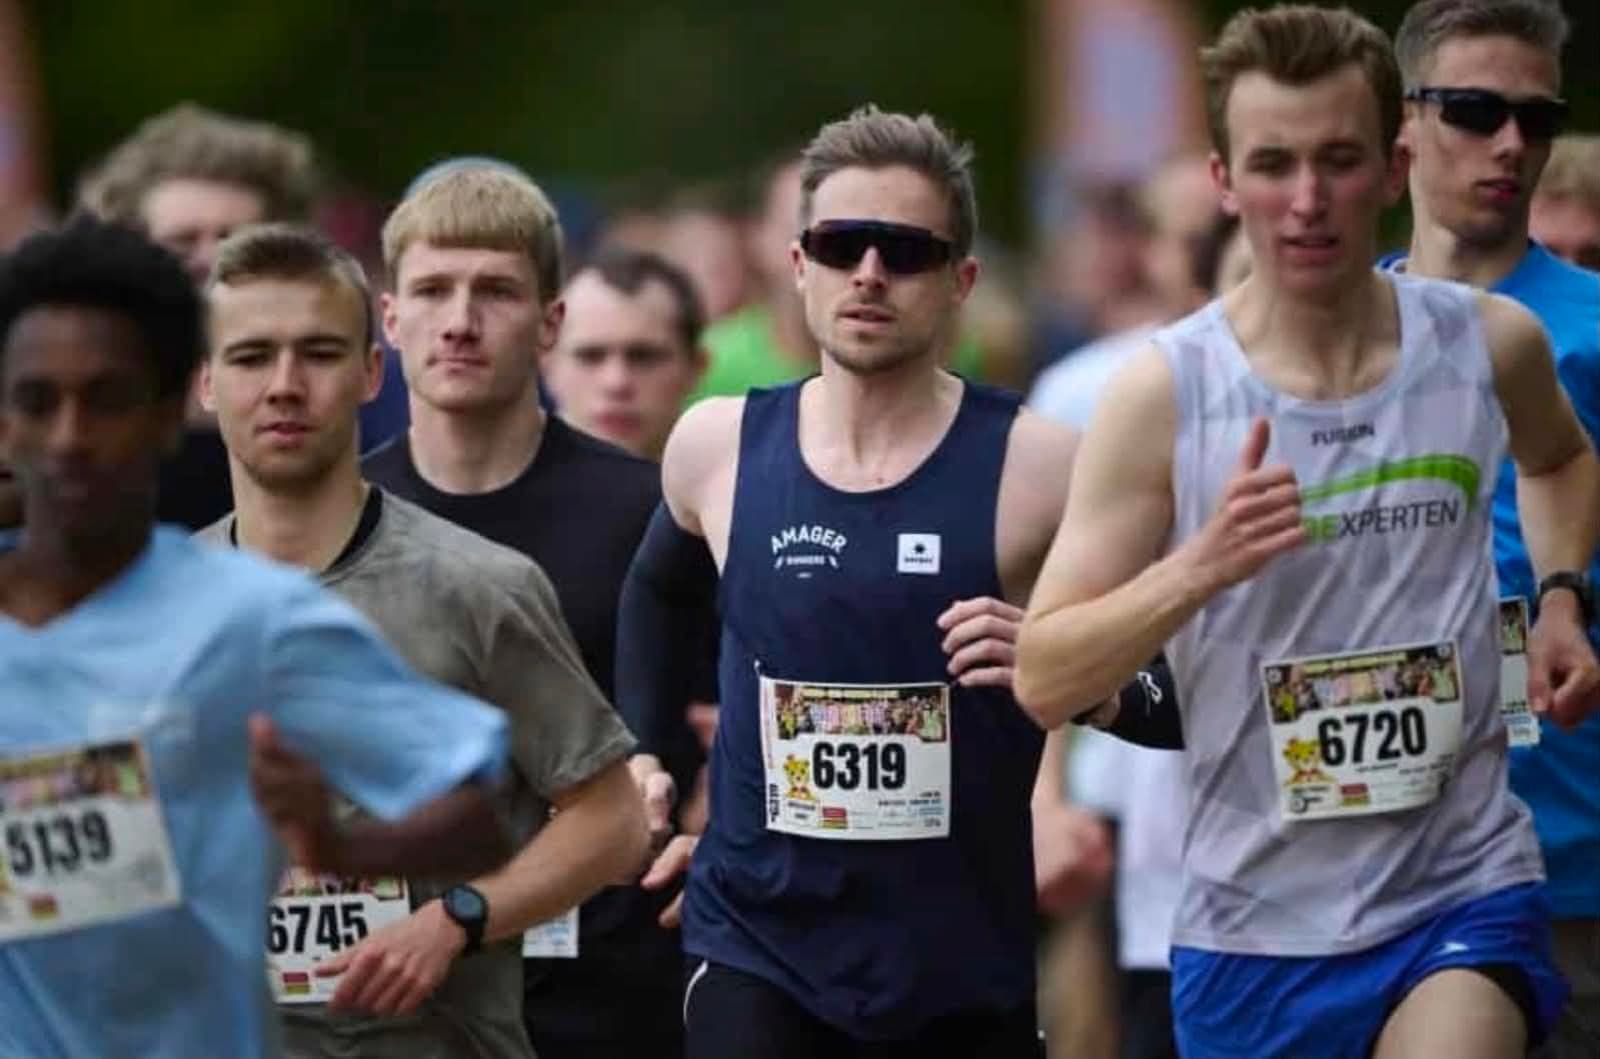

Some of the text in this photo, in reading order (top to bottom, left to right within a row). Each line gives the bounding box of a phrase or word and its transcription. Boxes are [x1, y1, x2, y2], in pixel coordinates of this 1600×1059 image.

[771, 523, 847, 554] AMAGER
[1318, 706, 1427, 766] 6720
[812, 741, 907, 791] 6319
[6, 811, 112, 876] 5139
[266, 903, 369, 954] 6745
